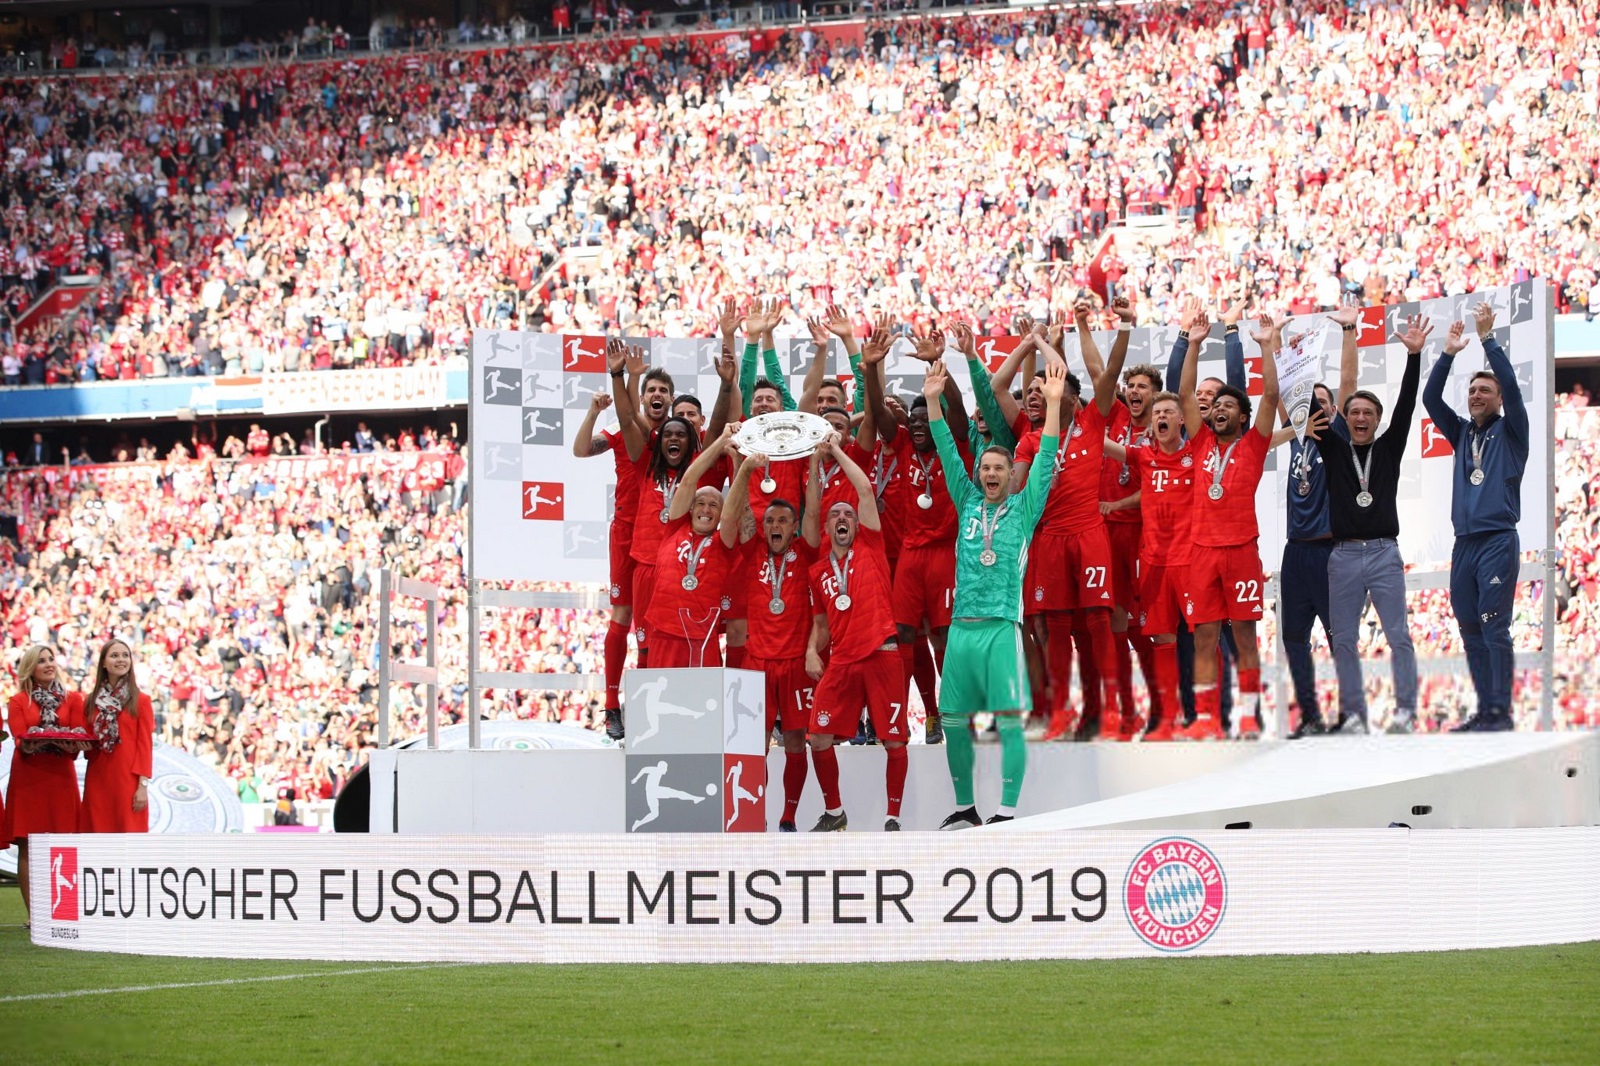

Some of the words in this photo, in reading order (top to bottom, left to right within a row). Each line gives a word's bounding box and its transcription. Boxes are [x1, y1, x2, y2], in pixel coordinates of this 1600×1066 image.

[1085, 566, 1106, 588] 27
[1235, 580, 1259, 602] 22
[795, 687, 814, 711] 13
[890, 702, 901, 724] 7
[1131, 860, 1152, 887] FC
[1152, 844, 1219, 887] BAYERN
[83, 866, 298, 921] DEUTSCHER
[319, 868, 915, 926] FUSSBALLMEISTER
[942, 866, 1108, 924] 2019
[51, 927, 79, 939] BUNDESLIGA
[1132, 905, 1219, 946] MÜNCHEN
